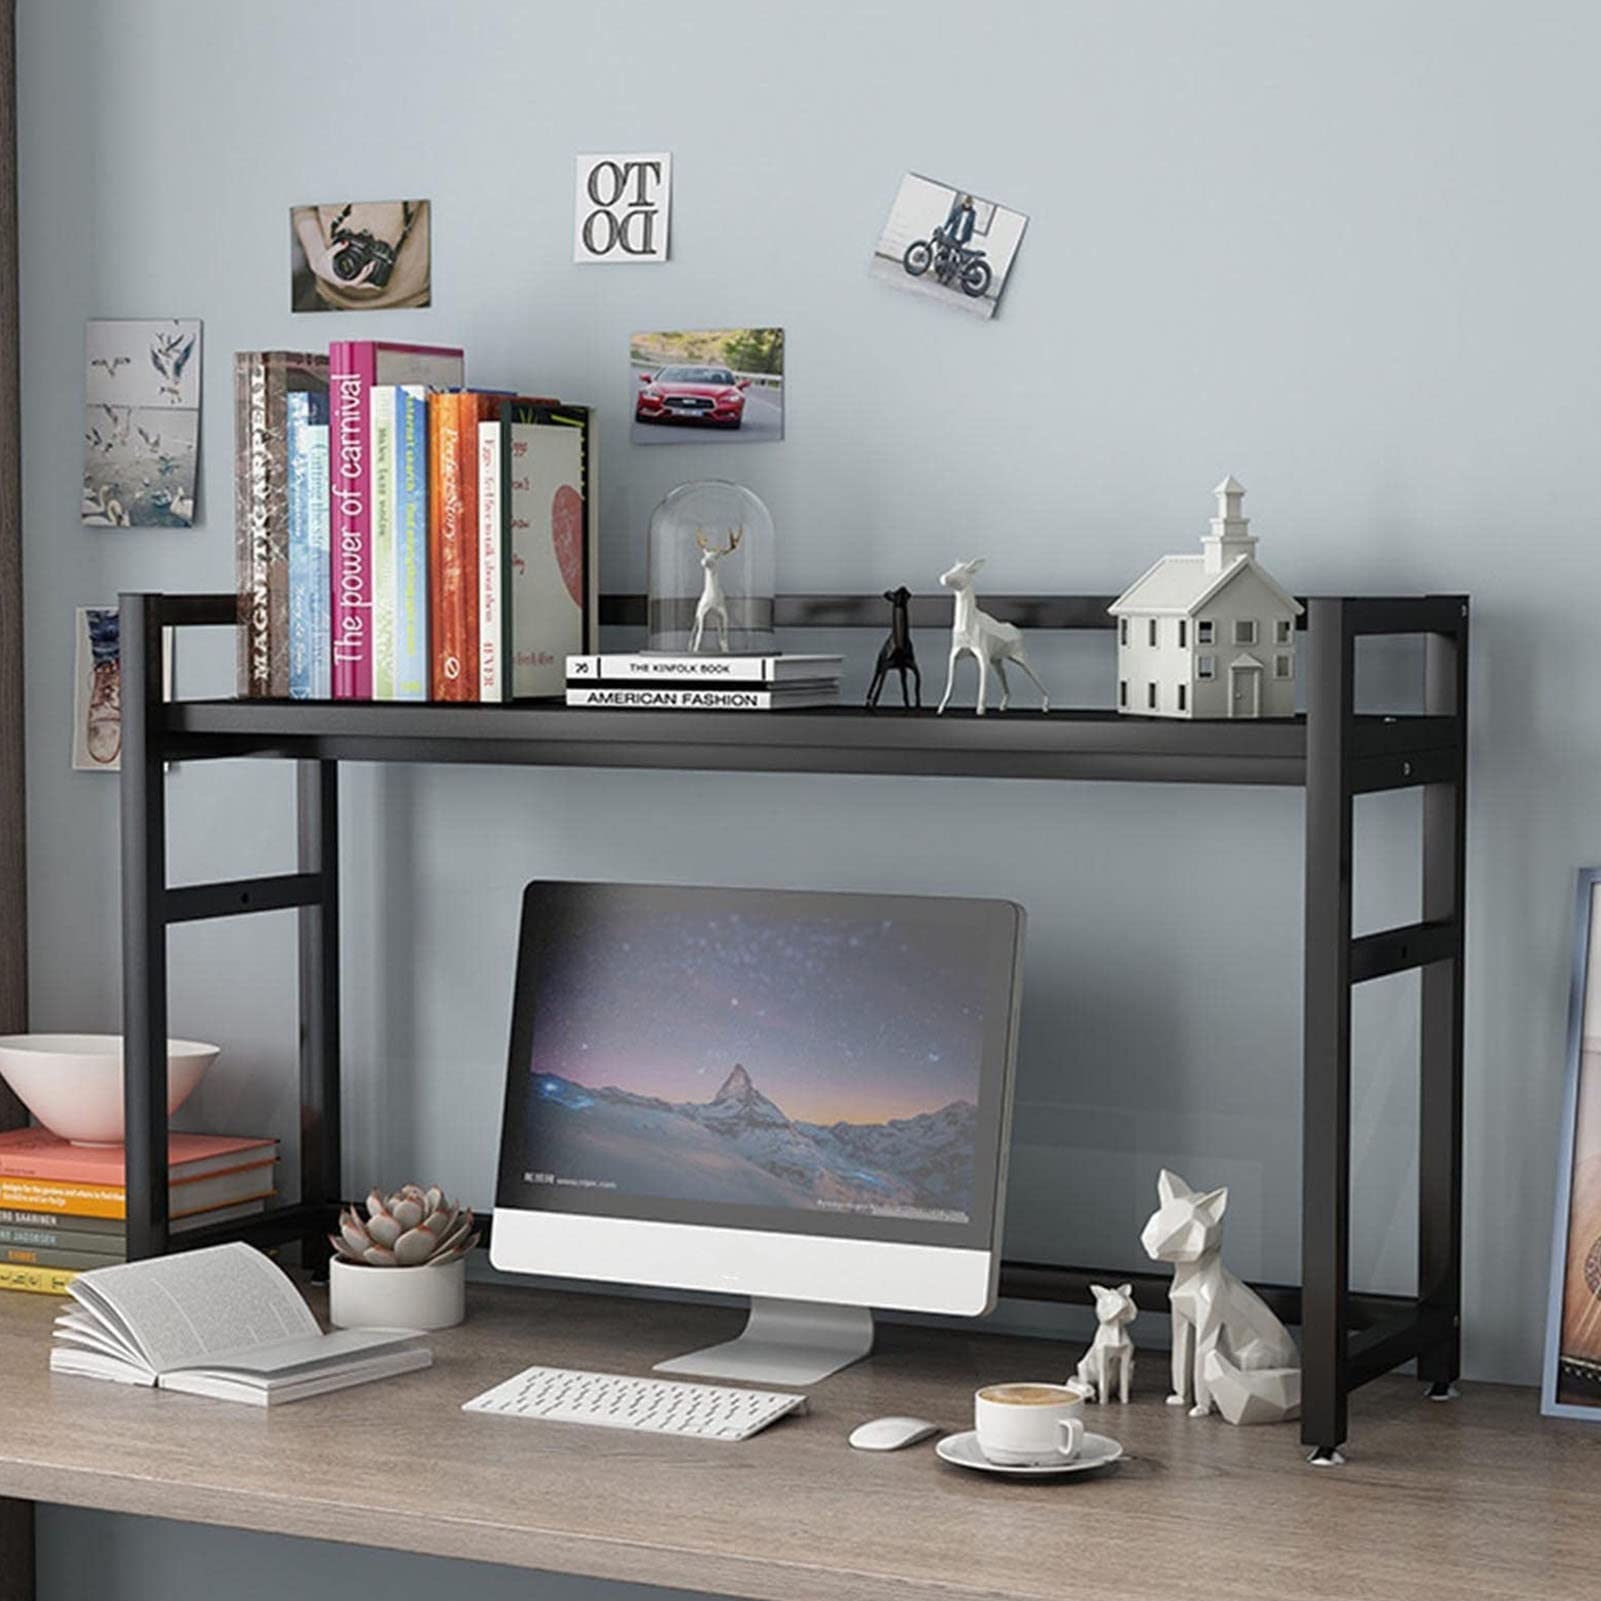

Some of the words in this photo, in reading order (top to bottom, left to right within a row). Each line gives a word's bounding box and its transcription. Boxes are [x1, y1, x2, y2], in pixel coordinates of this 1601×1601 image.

[250, 363, 266, 500] APPEAL
[331, 374, 362, 478] carnival
[332, 484, 362, 516] of
[341, 526, 373, 607] power
[333, 616, 364, 666] The
[629, 663, 650, 673] THE
[652, 664, 698, 674] KINFOLK
[700, 664, 731, 674] BOOK
[587, 692, 678, 705] AMERICAN
[682, 693, 758, 707] FASHION
